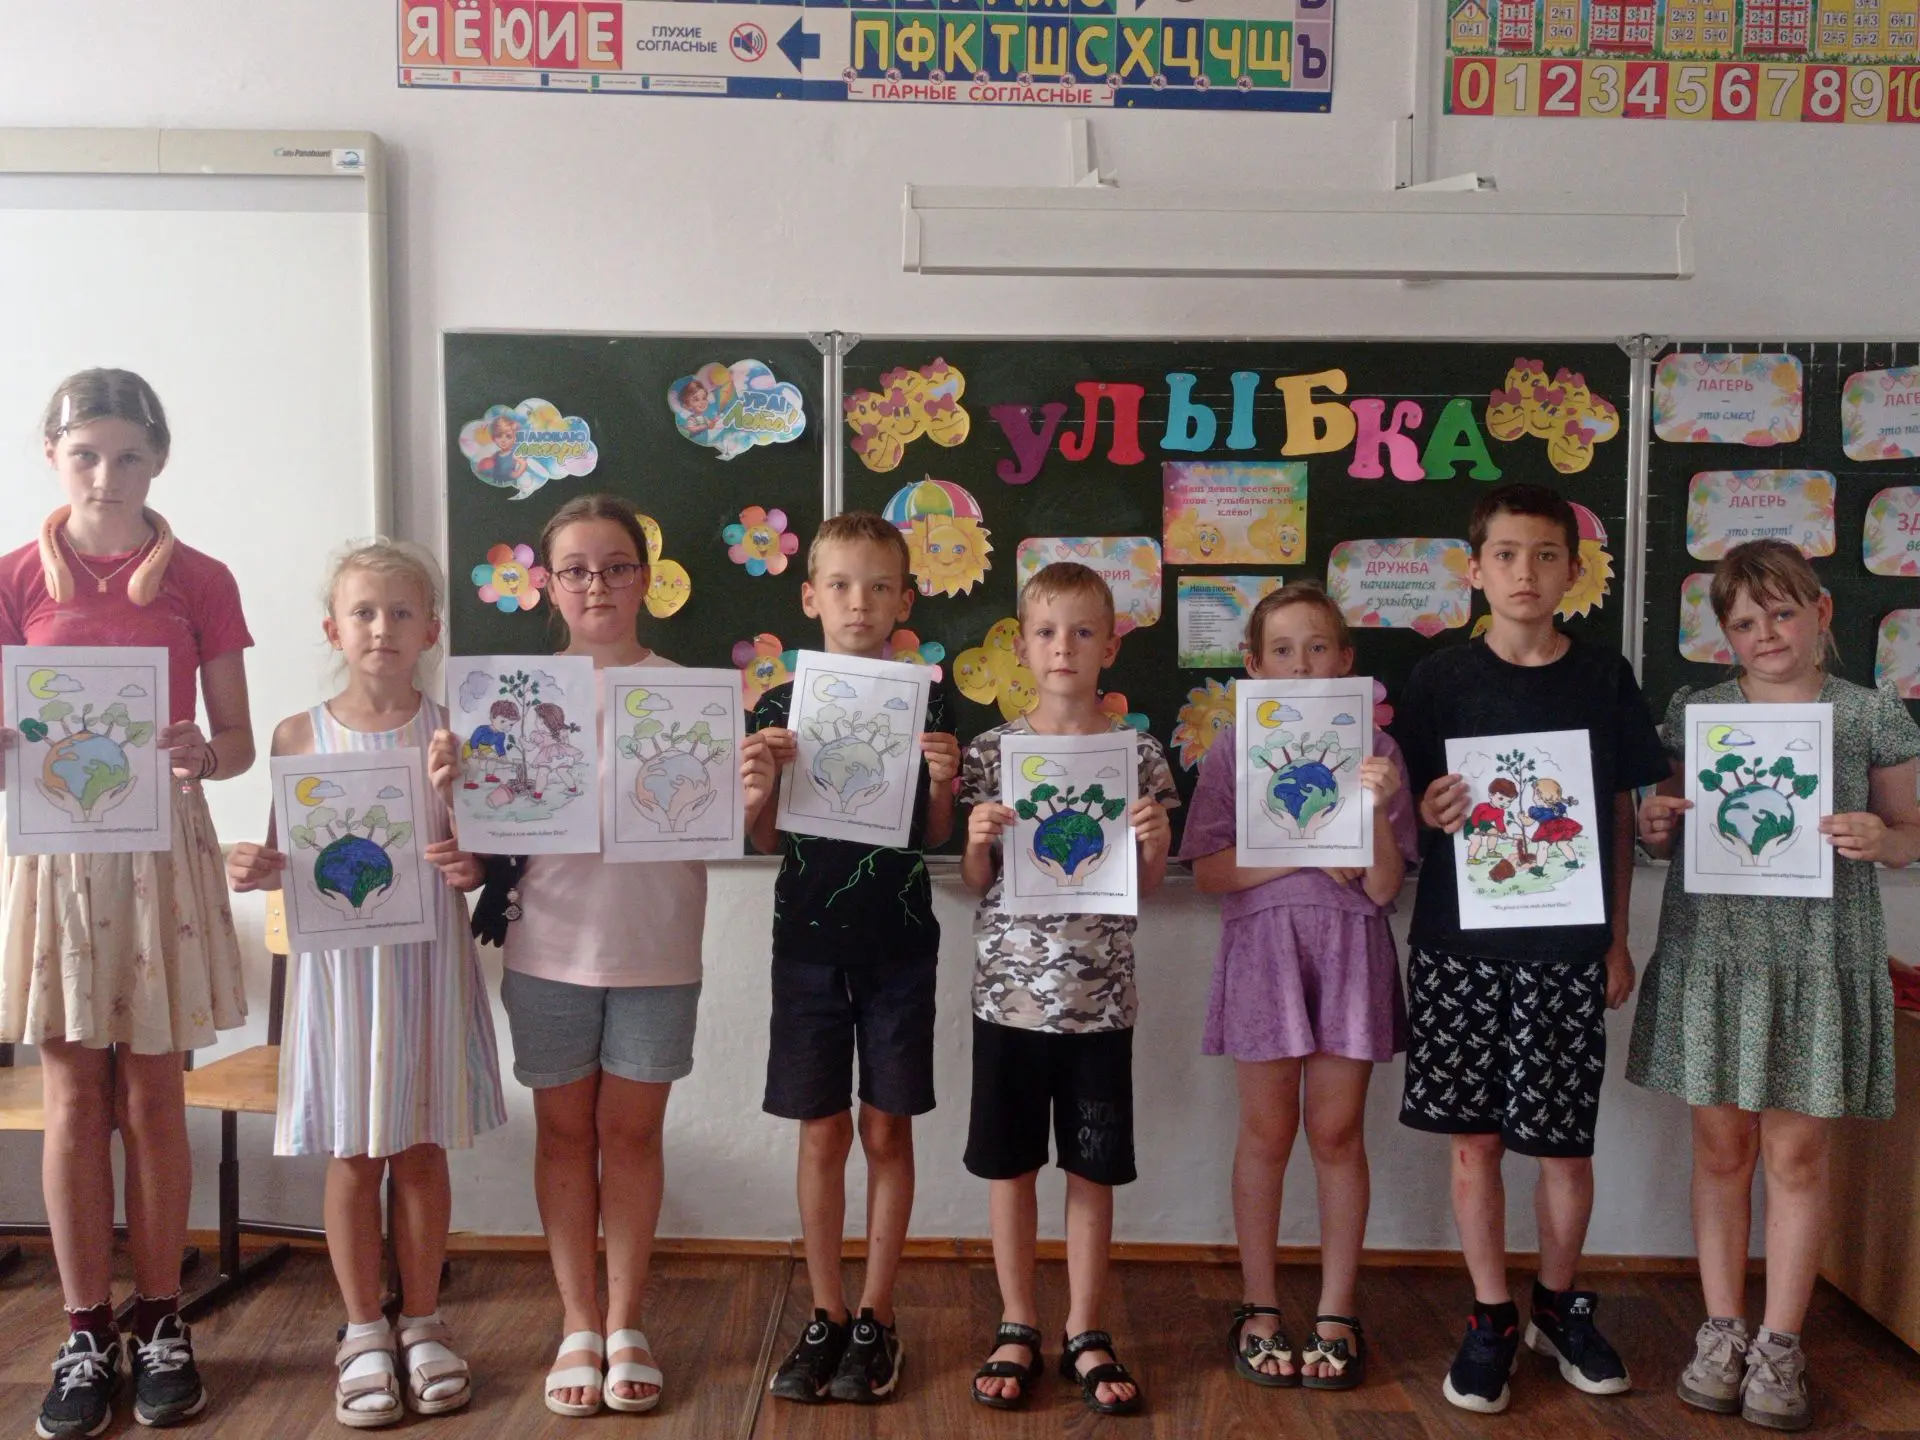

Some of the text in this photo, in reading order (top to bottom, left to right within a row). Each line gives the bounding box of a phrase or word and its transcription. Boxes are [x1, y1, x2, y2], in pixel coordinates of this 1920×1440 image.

[652, 26, 701, 39] ГЛУХИЕ
[636, 39, 718, 54] СОГЛАСНЫЕ
[872, 84, 1093, 104] ПАРНЫЕ СОГЛАСНЫЕ
[1697, 379, 1754, 392] ЛАГЕРЬ
[1696, 409, 1755, 421] это смех!
[989, 368, 1503, 485] УЛЫБКА
[1728, 495, 1786, 508] ЛАГЕРЬ
[1725, 524, 1794, 540] это спорт!
[1365, 561, 1429, 576] ДРУЖБА
[1360, 579, 1437, 591] начинается
[1375, 593, 1429, 610] улыбки!
